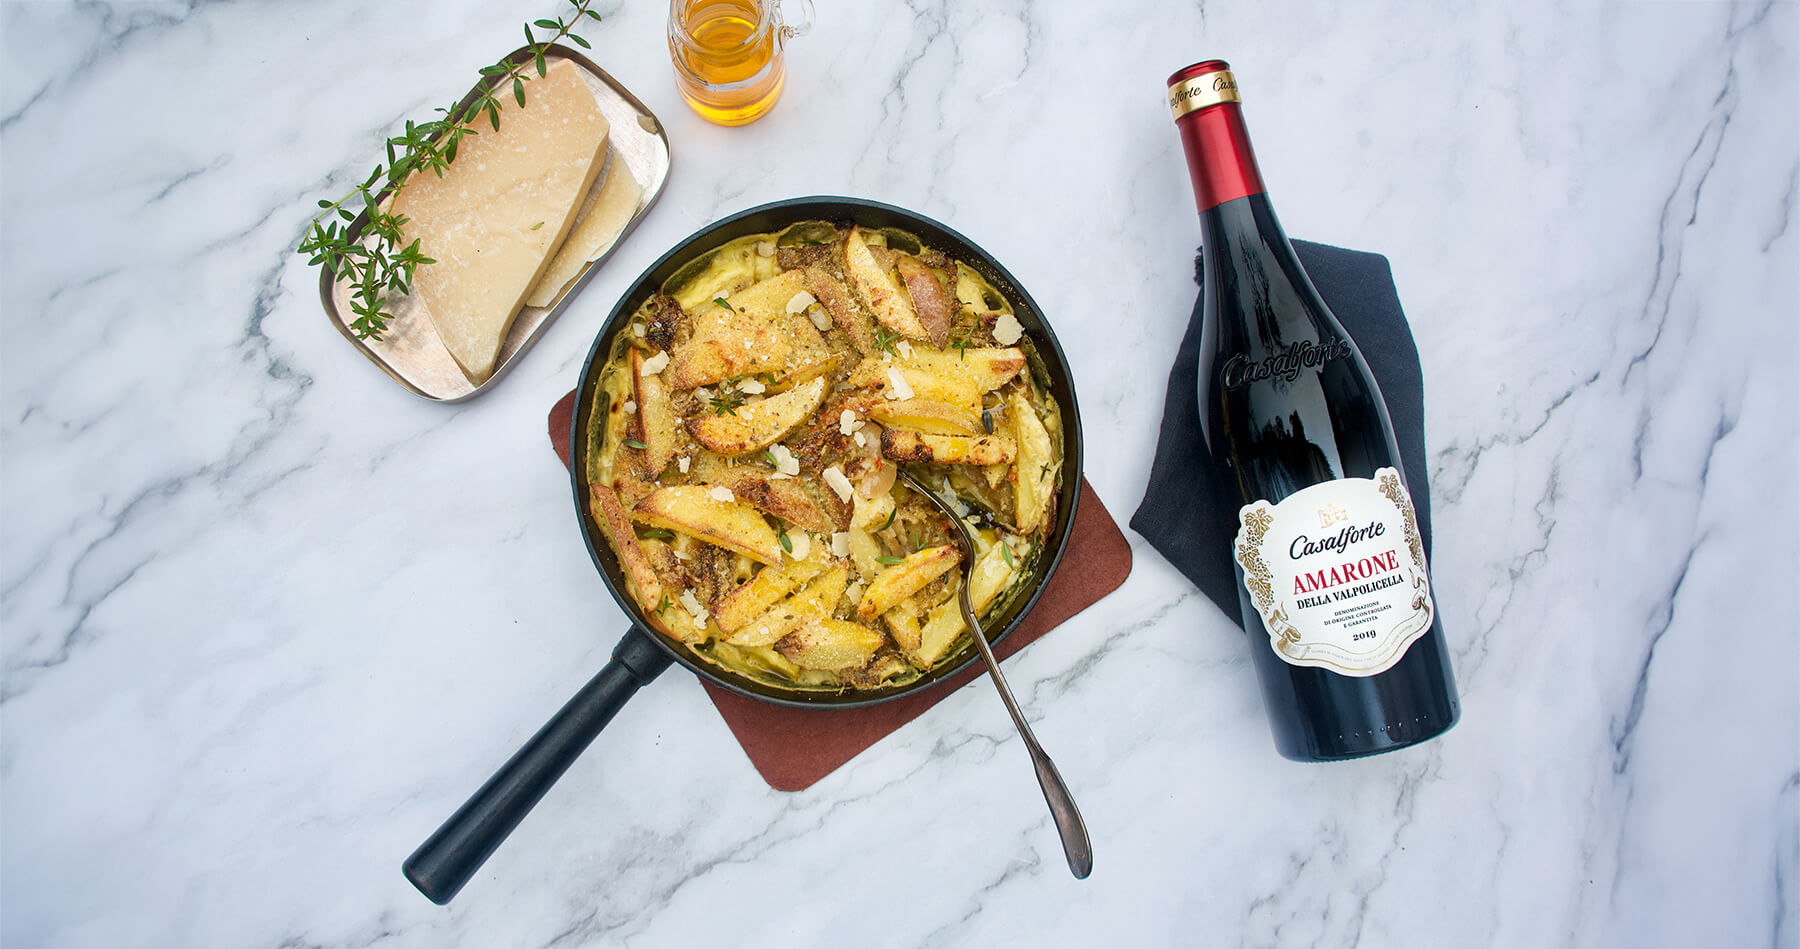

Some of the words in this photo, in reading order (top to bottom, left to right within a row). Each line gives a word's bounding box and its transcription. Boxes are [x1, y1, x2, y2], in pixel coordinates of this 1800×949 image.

[1220, 336, 1352, 391] Casalforte
[1289, 521, 1385, 560] Casalforte
[1293, 549, 1400, 595] AMARONE
[1296, 594, 1332, 610] DELLA
[1333, 574, 1404, 600] VALPOLICELLA
[1331, 614, 1355, 624] ORIGINE
[1355, 604, 1392, 618] CONTROLLATA
[1334, 601, 1380, 617] DENOMINAZIONE
[1348, 615, 1378, 627] GARANTITA
[1353, 630, 1376, 641] 2019
